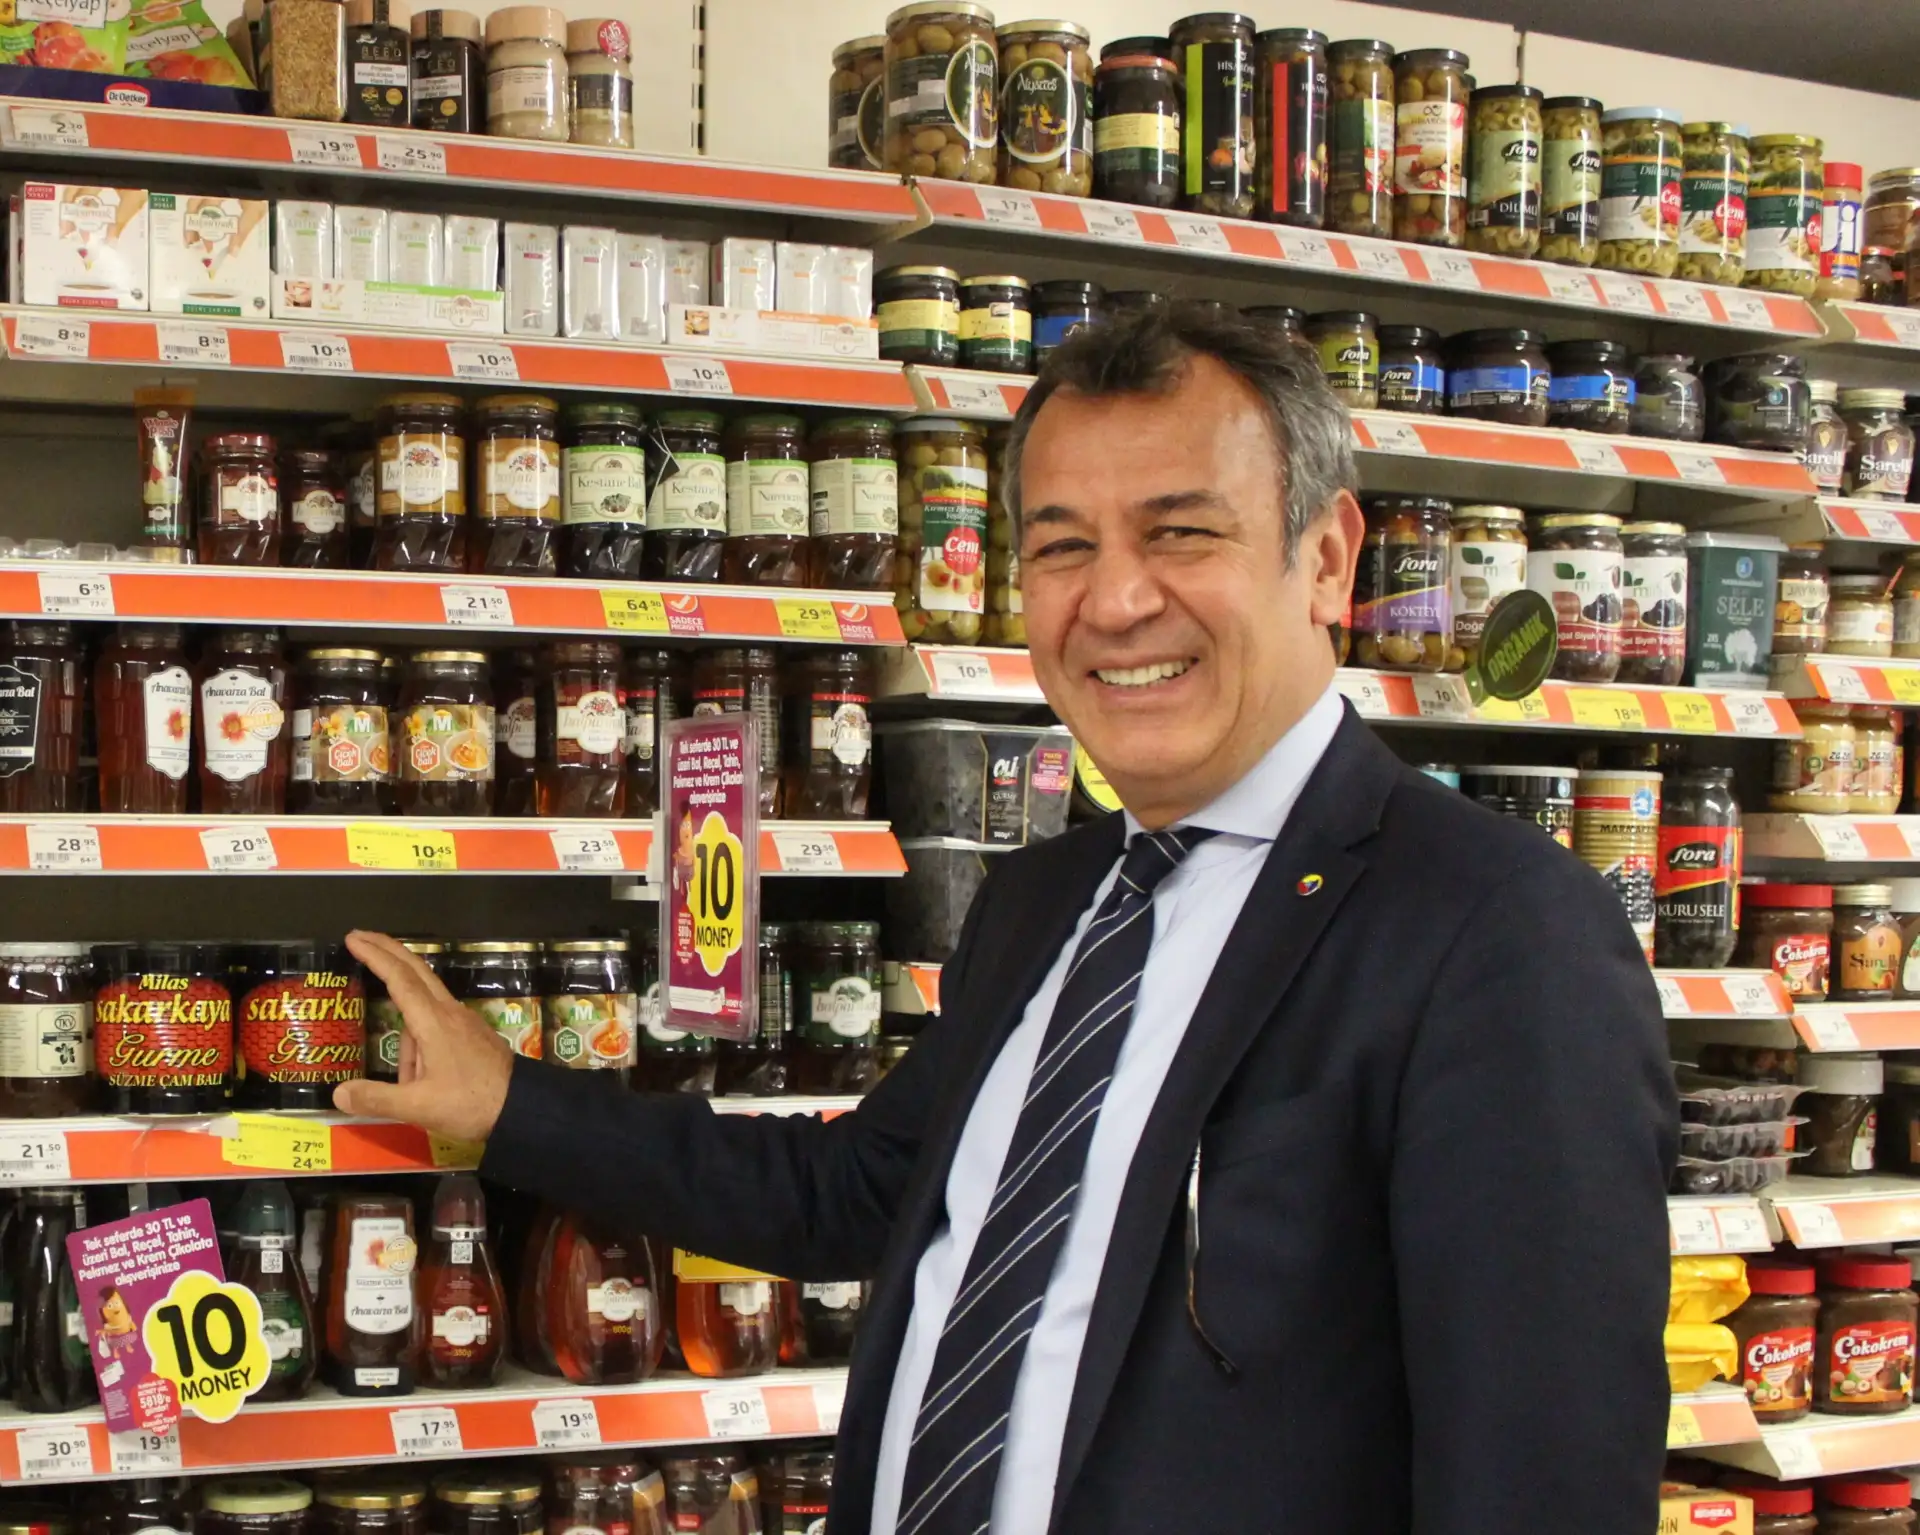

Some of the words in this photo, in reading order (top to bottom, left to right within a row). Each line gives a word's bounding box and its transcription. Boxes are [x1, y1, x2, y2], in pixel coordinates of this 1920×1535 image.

[1339, 347, 1371, 363] fora
[1380, 368, 1412, 383] fora
[945, 536, 980, 555] Cem
[1394, 556, 1438, 574] fora
[1716, 595, 1765, 618] SELE
[17, 685, 36, 698] Bal
[205, 684, 248, 698] Anavarza
[249, 684, 267, 697] Bal
[1668, 846, 1718, 865] fora
[695, 841, 735, 921] 10
[1657, 902, 1698, 917] KURU
[696, 925, 734, 949] MONEY
[138, 973, 190, 992] Milas
[303, 971, 348, 988] Milas
[96, 992, 232, 1032] sakarkaya
[108, 1033, 221, 1069] Gurme
[108, 1073, 157, 1087] SÜZME
[159, 1074, 194, 1090] ÇAM
[196, 1073, 223, 1087] BALI
[268, 1069, 321, 1084] SÜZME
[324, 1070, 351, 1087] ÇAM
[103, 1226, 144, 1247] seferde
[144, 1220, 161, 1235] 30
[161, 1216, 176, 1230] TL
[176, 1214, 192, 1226] ve
[78, 1261, 120, 1282] Pekmez
[120, 1257, 136, 1270] ve
[136, 1249, 167, 1267] Krem
[167, 1237, 214, 1261] Çikolata
[114, 1260, 181, 1287] alışverişinize
[156, 1292, 247, 1379] 10
[1748, 1339, 1813, 1372] Çokokrem
[1834, 1333, 1910, 1364] Çokokrem
[180, 1367, 252, 1402] MONEY
